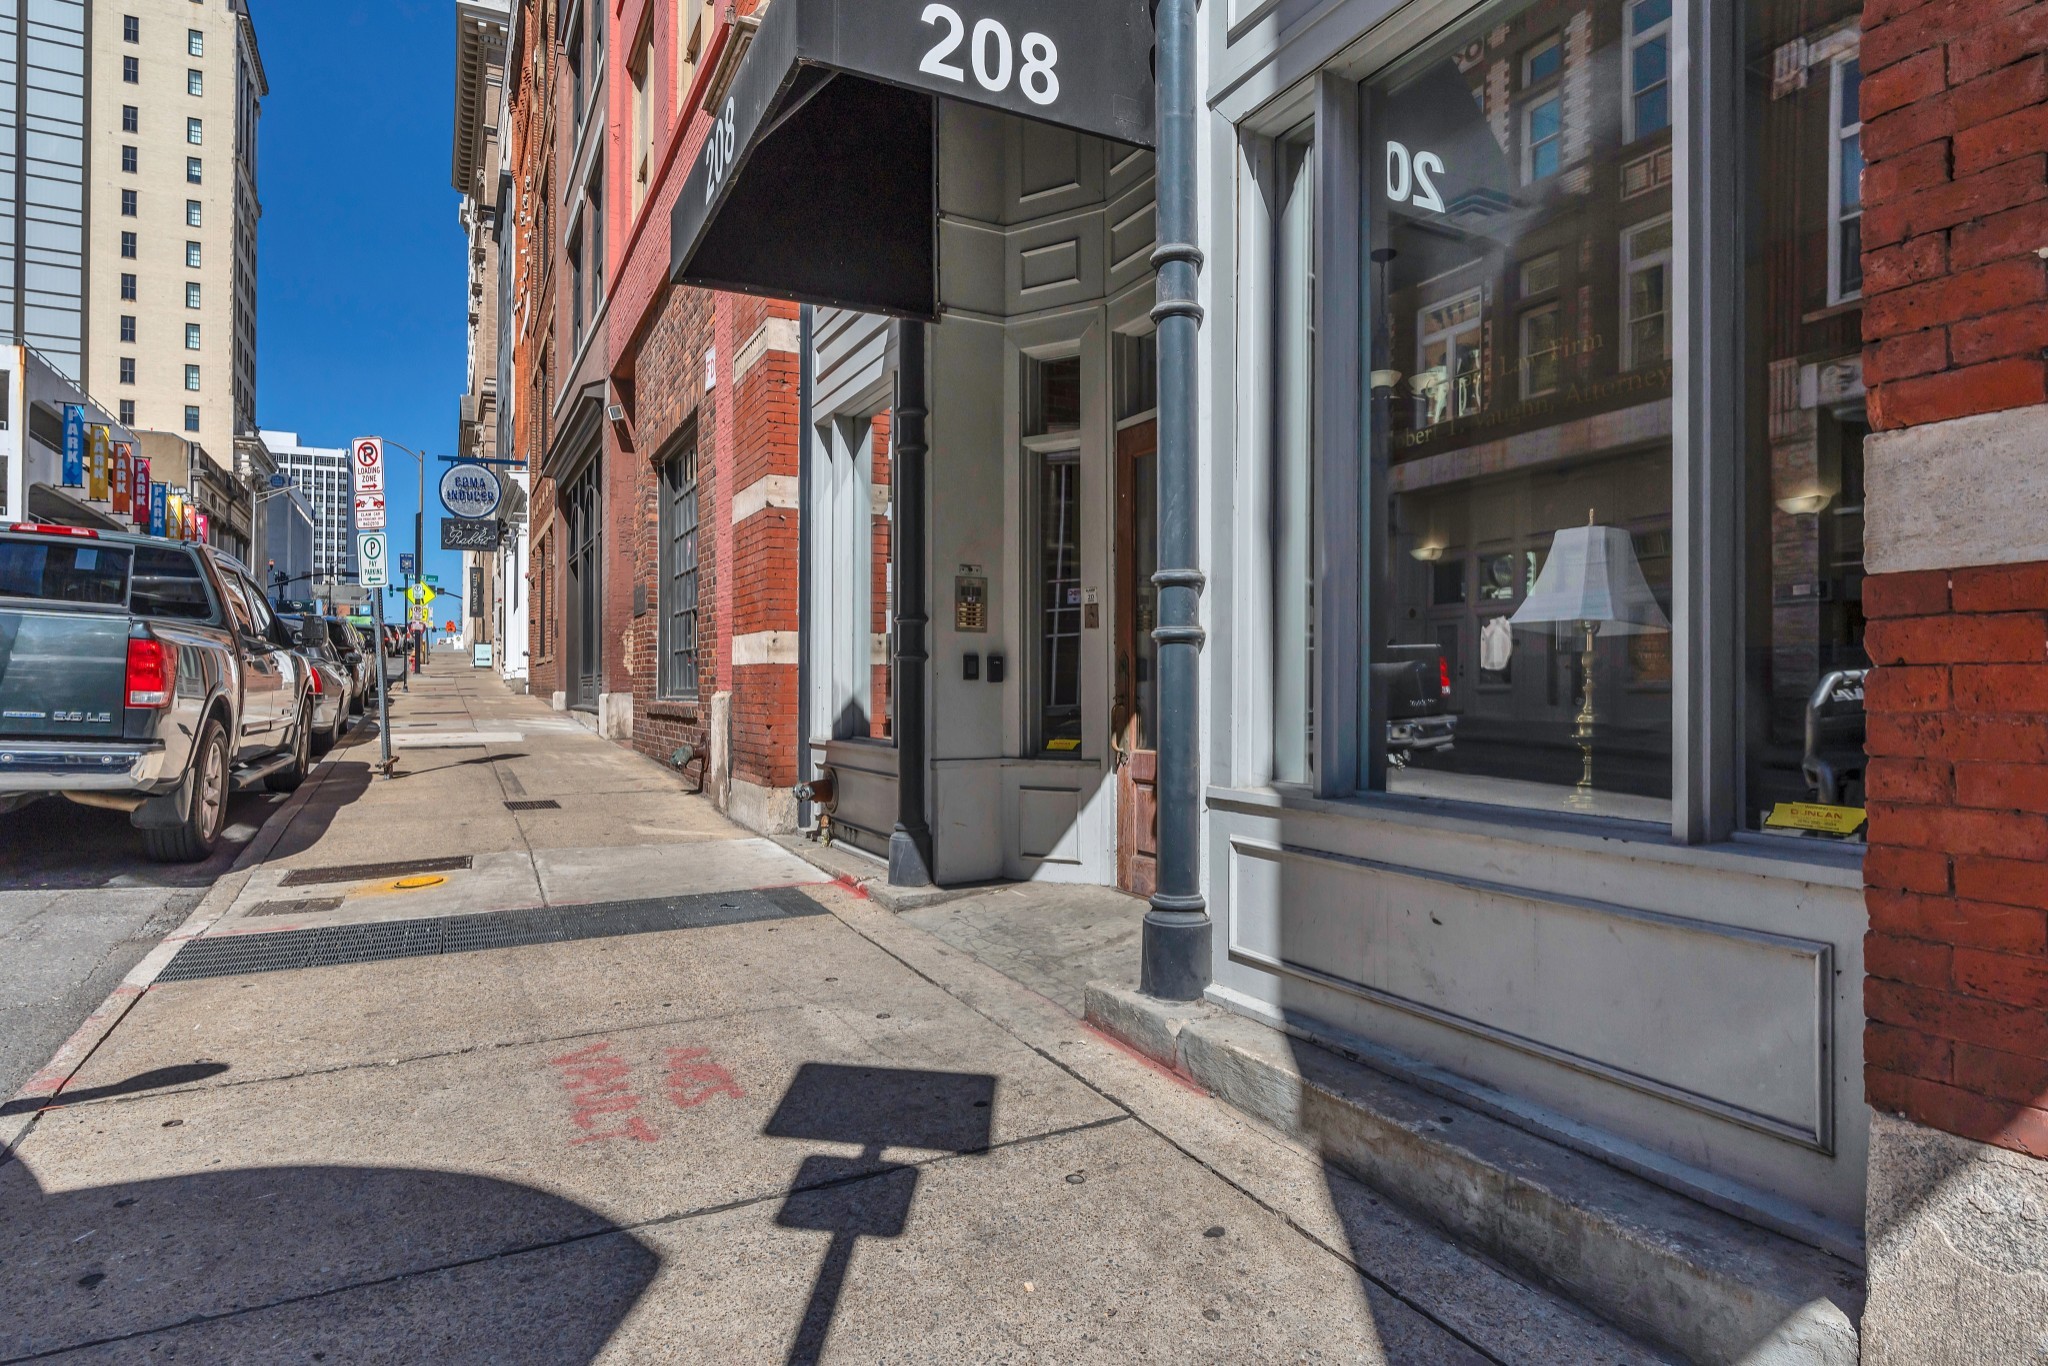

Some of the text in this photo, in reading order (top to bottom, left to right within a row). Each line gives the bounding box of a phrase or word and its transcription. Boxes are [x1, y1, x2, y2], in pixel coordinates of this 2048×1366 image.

[919, 3, 1060, 105] 208
[705, 96, 735, 206] 208
[1550, 333, 1605, 361] Firm
[706, 358, 715, 379] FD
[67, 408, 79, 464] PARK
[1389, 426, 1438, 449] obert
[93, 429, 104, 479] PARK
[116, 448, 127, 494] PARK
[357, 466, 381, 475] LOADING
[361, 475, 377, 483] ZONE
[454, 476, 486, 489] COMA
[136, 461, 146, 506] PARK
[153, 486, 163, 528] PARK
[447, 490, 495, 503] INDUCER
[370, 541, 376, 556] P
[53, 711, 83, 722] 5.6
[86, 711, 111, 722] LE
